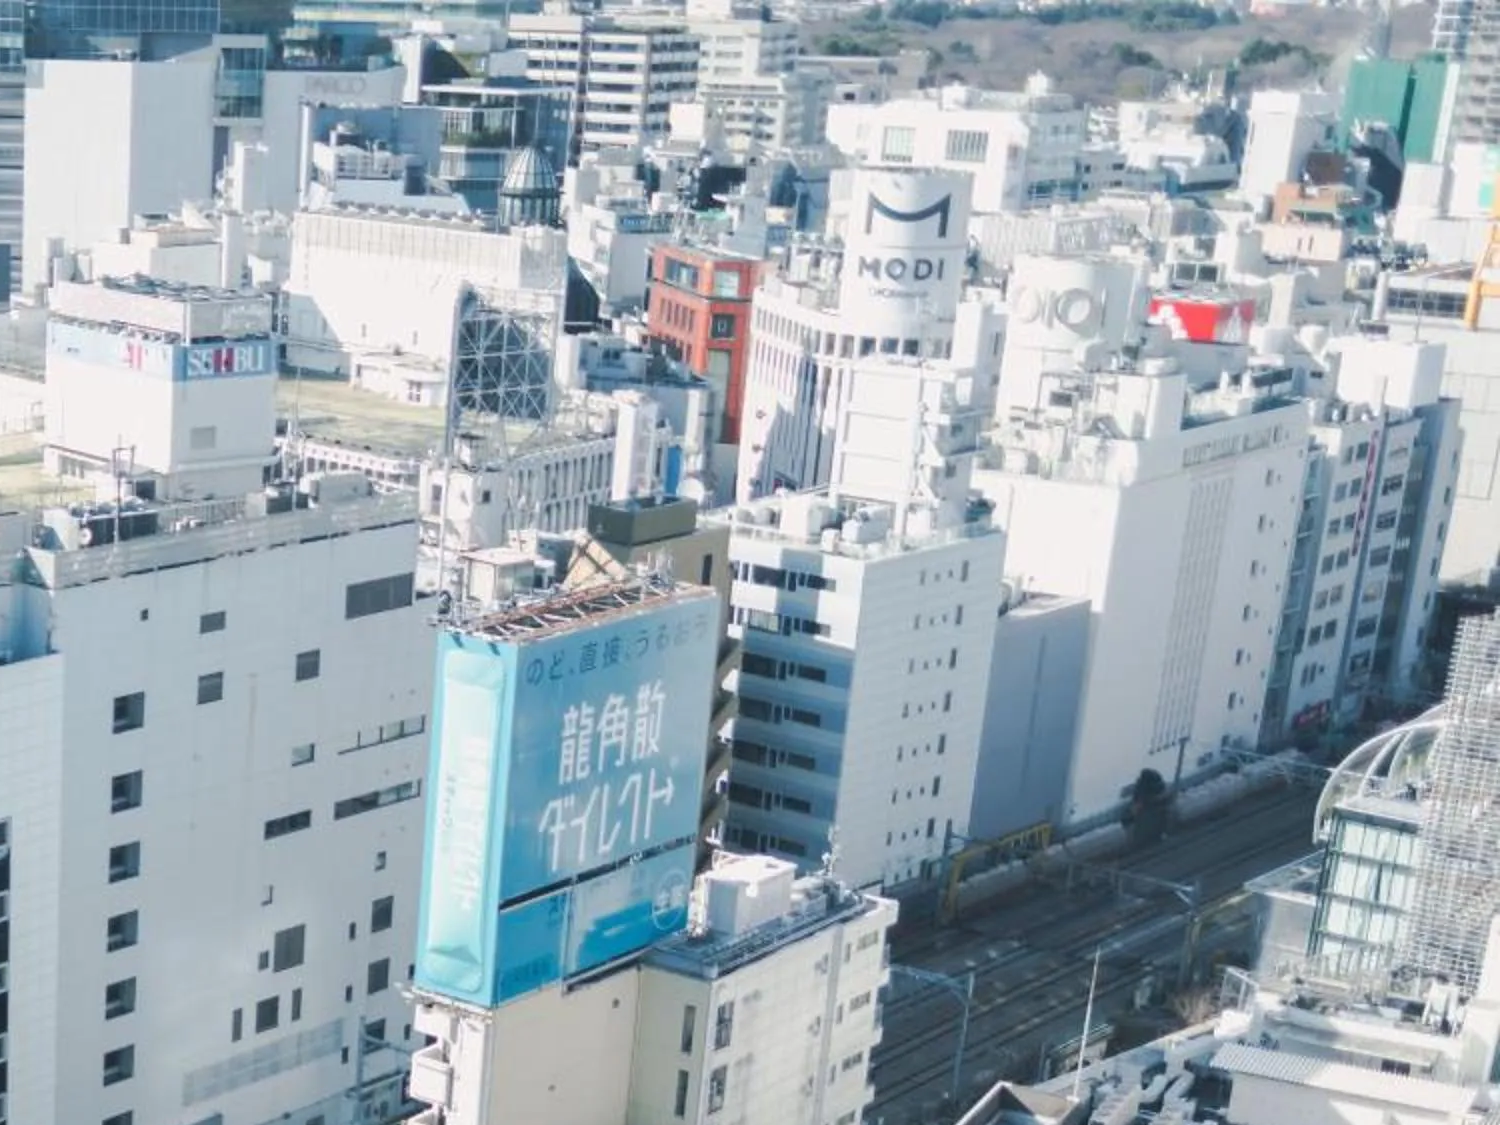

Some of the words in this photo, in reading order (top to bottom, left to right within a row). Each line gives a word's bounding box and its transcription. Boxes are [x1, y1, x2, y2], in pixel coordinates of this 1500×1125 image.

[858, 255, 945, 282] MODI
[557, 679, 668, 786] 龍角散
[537, 766, 676, 873] ダイレクト
